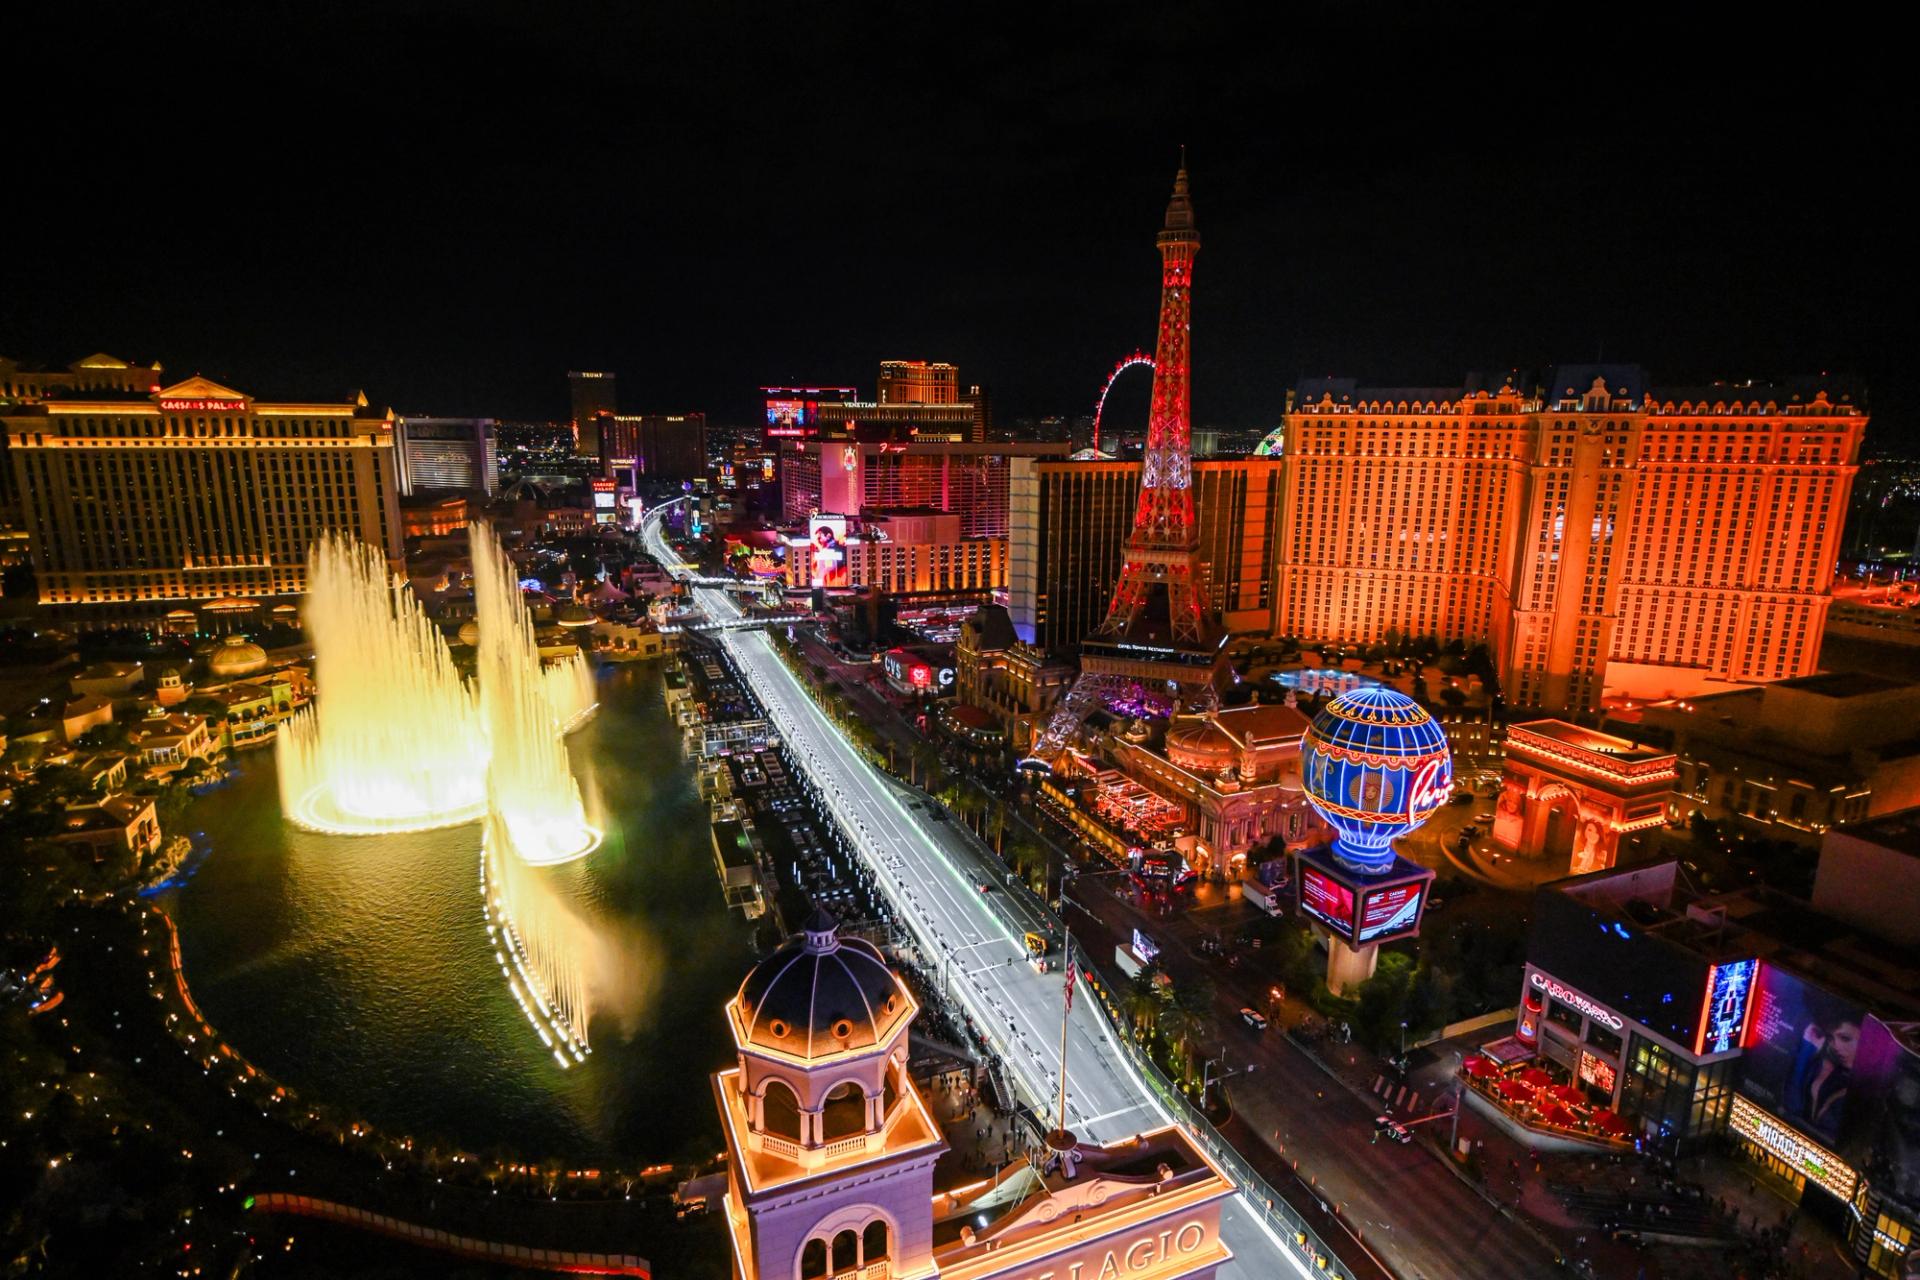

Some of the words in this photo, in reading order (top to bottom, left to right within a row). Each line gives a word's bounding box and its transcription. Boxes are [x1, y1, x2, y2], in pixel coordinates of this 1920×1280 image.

[161, 401, 205, 409] CAESARS
[207, 402, 245, 410] PALACE
[884, 655, 901, 680] CVS
[1408, 758, 1455, 827] Paris
[1531, 973, 1576, 1004] CABO
[1758, 1122, 1806, 1164] MIRACLE
